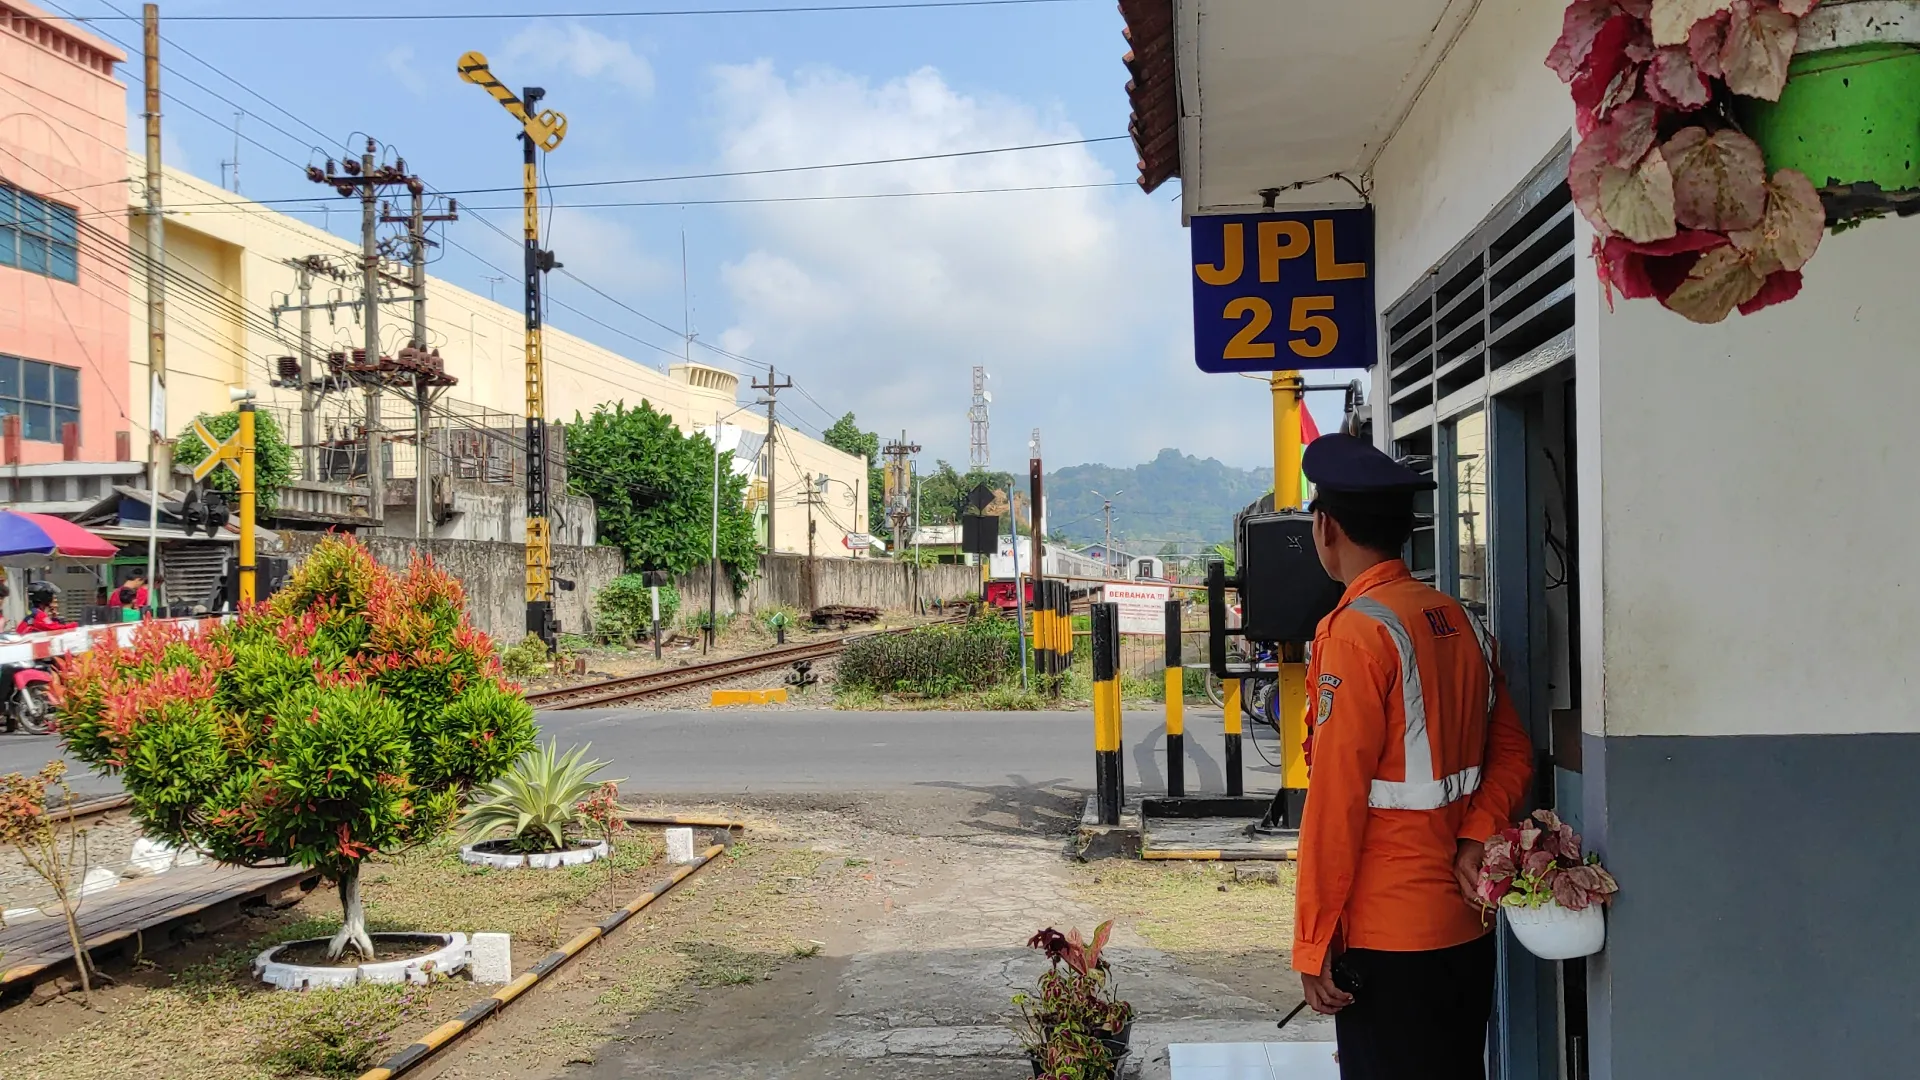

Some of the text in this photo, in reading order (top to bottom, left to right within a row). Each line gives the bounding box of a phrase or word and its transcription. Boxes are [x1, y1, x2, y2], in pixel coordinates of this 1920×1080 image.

[1194, 219, 1366, 286] JPL
[1222, 295, 1339, 359] 25
[1109, 591, 1156, 600] BERBAHAYA
